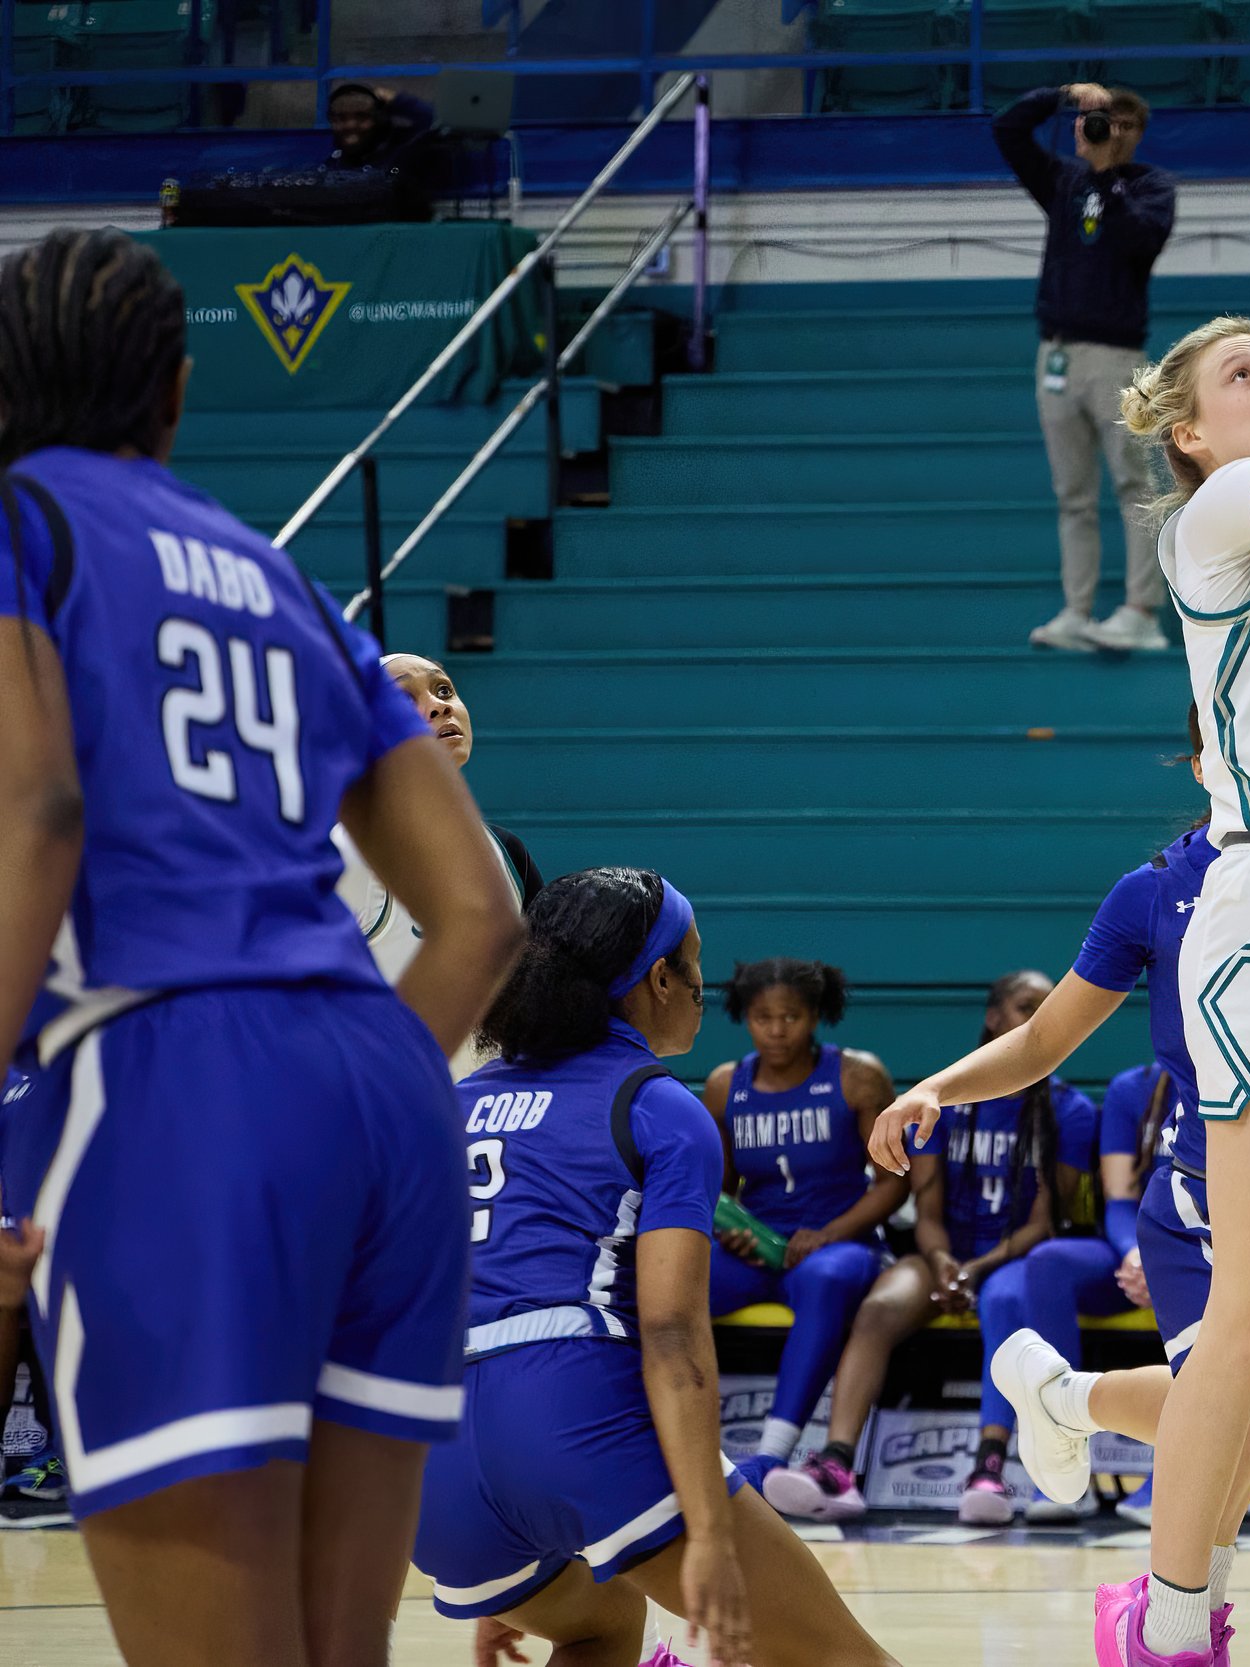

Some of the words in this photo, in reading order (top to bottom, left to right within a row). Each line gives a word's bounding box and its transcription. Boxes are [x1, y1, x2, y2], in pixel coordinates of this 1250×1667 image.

[149, 527, 275, 618] DABO
[157, 617, 305, 824] 24
[465, 1091, 553, 1133] COBB
[733, 1107, 831, 1150] HAMPTON
[776, 1154, 795, 1194] 1
[982, 1176, 1004, 1214] 4
